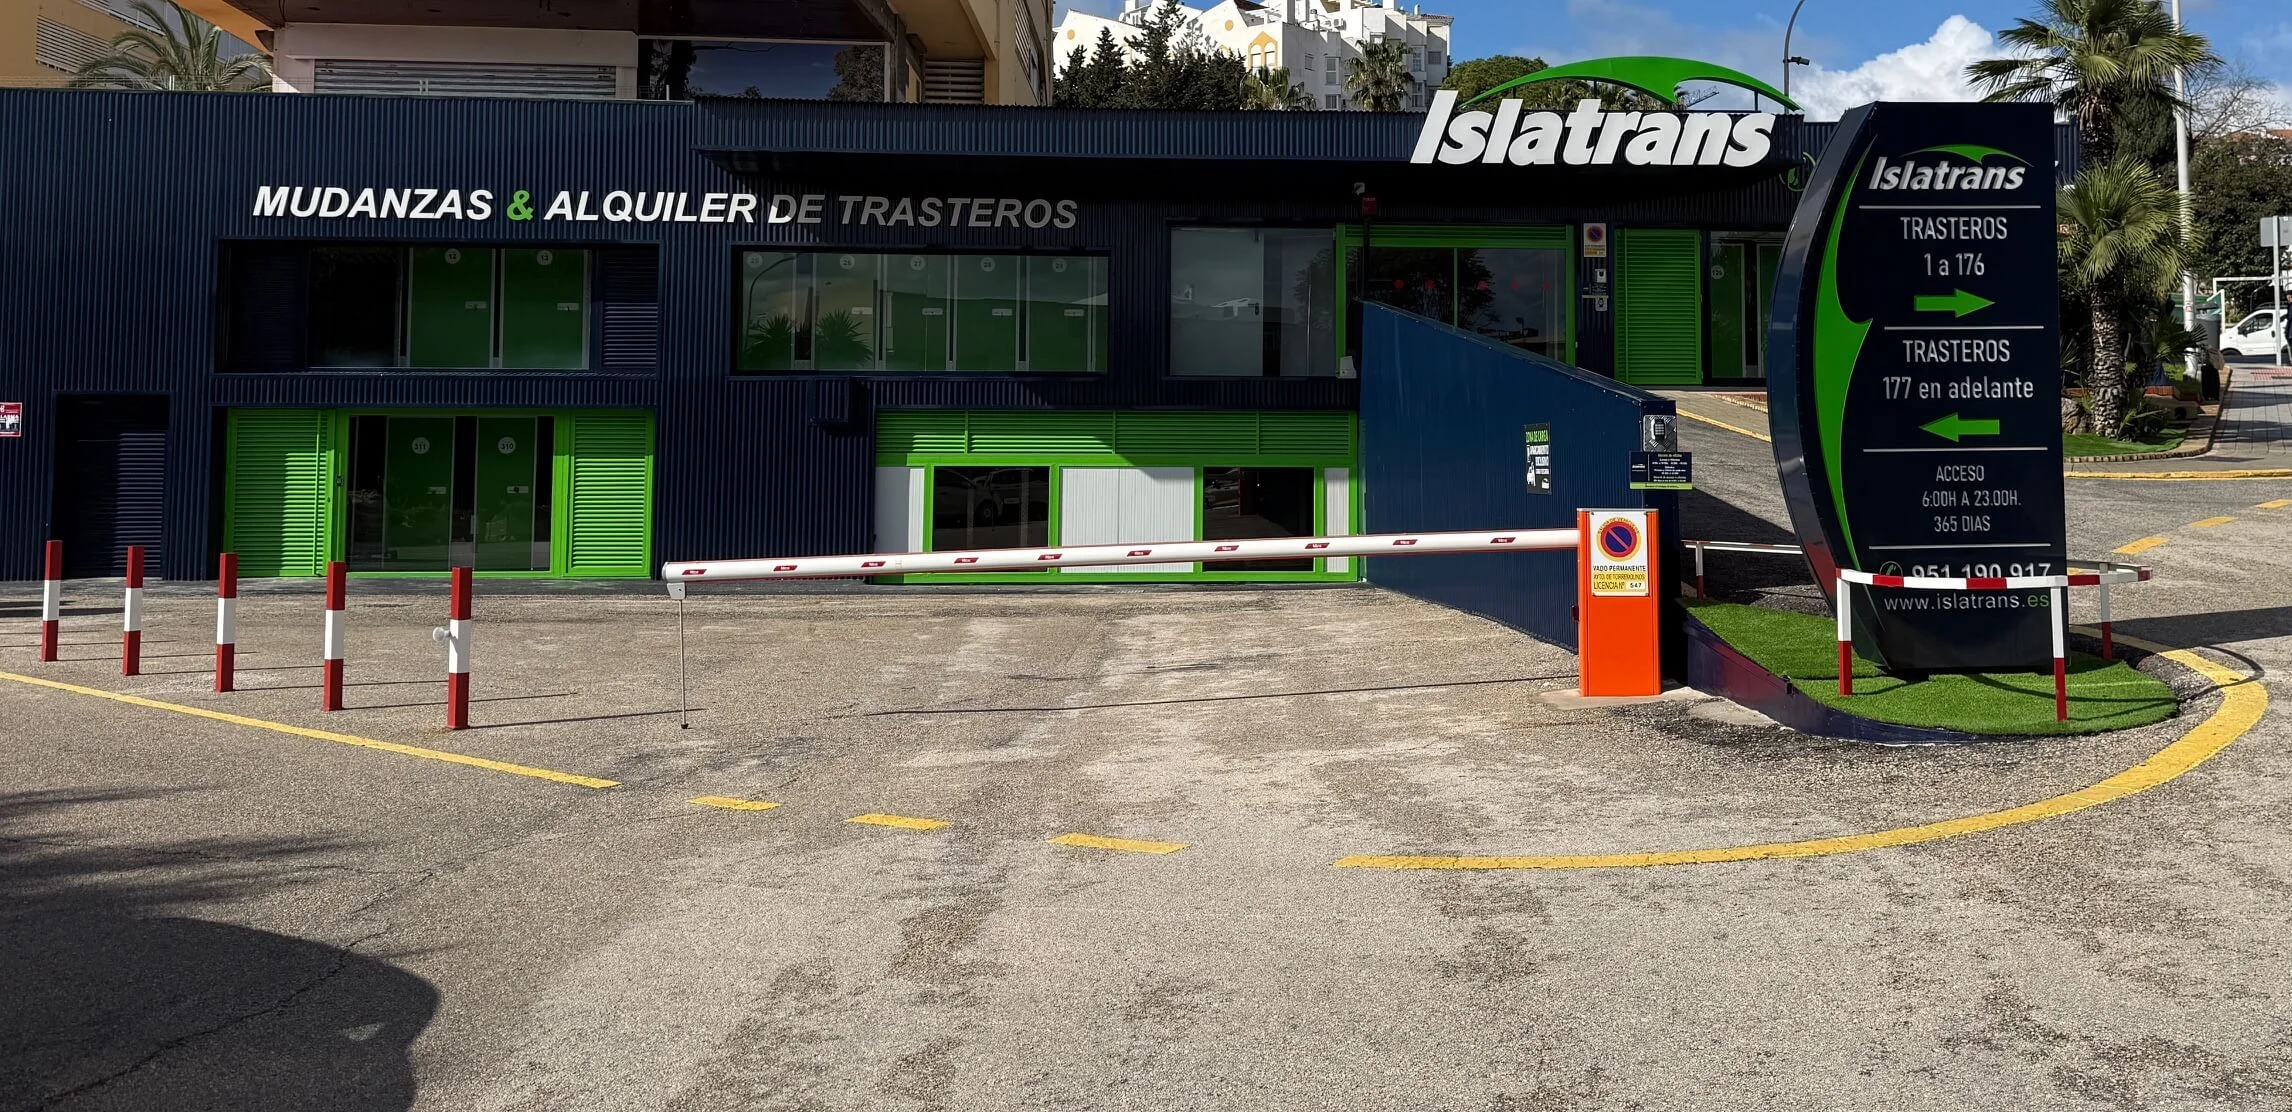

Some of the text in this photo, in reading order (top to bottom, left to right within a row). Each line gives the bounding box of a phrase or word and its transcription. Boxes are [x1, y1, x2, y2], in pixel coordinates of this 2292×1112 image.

[1409, 89, 1777, 168] Islatrans
[1868, 156, 2027, 191] Islatrans
[252, 185, 1078, 229] MUDANZAS & ALQUILER DE TRASTEROS
[1900, 216, 2008, 240] TRASTEROS
[1923, 253, 1985, 276] 1 a 176
[1902, 339, 2010, 363] TRASTEROS
[1882, 375, 2034, 399] 177 en adelante
[1935, 465, 1985, 482] ACCESO
[1922, 490, 1957, 507] 6:00H
[1961, 491, 1970, 506] A
[1934, 515, 1991, 532] 365 DIAS
[1911, 561, 2051, 579] 951 190 917
[1593, 581, 1618, 590] LICENCIA
[1884, 591, 2049, 610] www.islatrans.es
